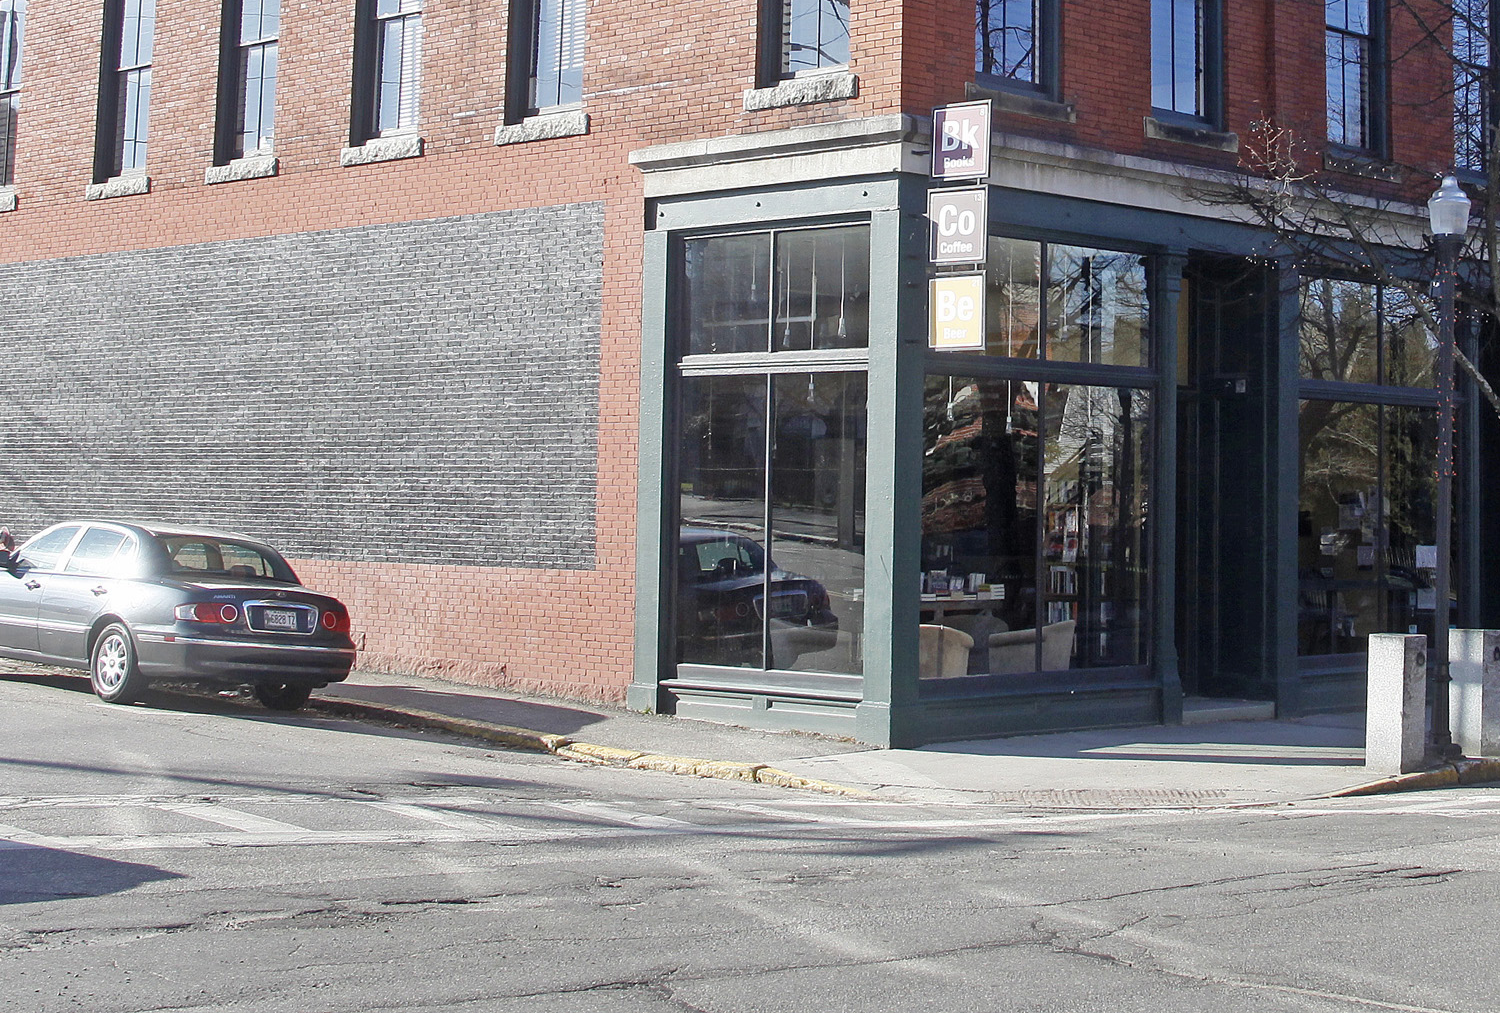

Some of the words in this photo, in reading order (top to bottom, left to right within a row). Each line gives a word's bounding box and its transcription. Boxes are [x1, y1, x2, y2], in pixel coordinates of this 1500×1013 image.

[941, 119, 979, 151] Bk
[943, 156, 975, 168] Books
[974, 193, 982, 201] 13
[938, 204, 976, 237] Co
[940, 240, 973, 254] Coffee
[971, 279, 980, 287] 21
[937, 290, 974, 322] Be
[943, 327, 968, 340] Beer
